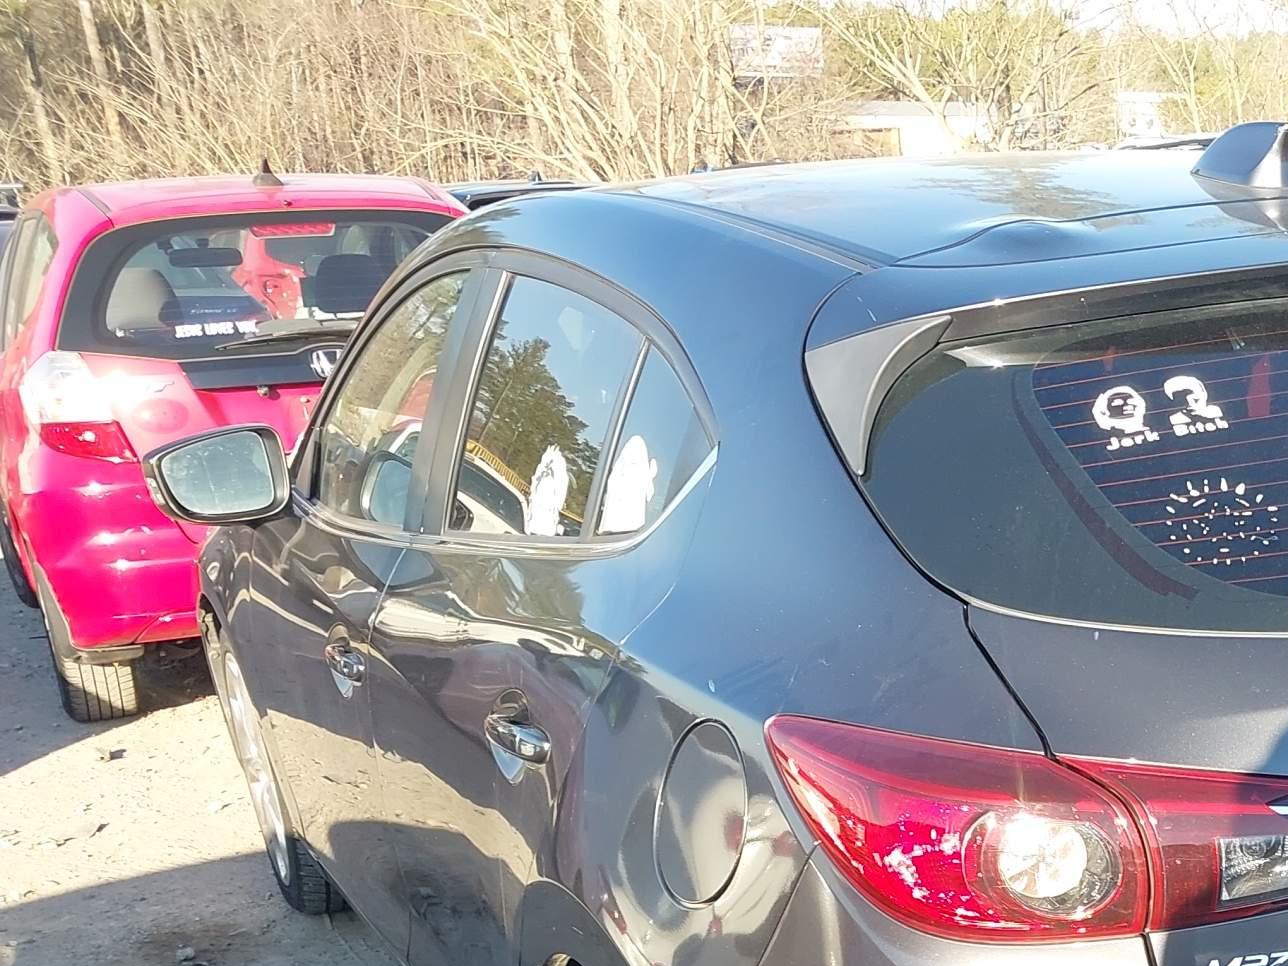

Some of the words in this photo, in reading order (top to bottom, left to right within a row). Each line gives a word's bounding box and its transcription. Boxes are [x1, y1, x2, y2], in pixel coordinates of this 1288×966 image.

[204, 321, 236, 335] LOVES
[1106, 430, 1160, 450] Jerk
[1173, 417, 1229, 436] Bitch
